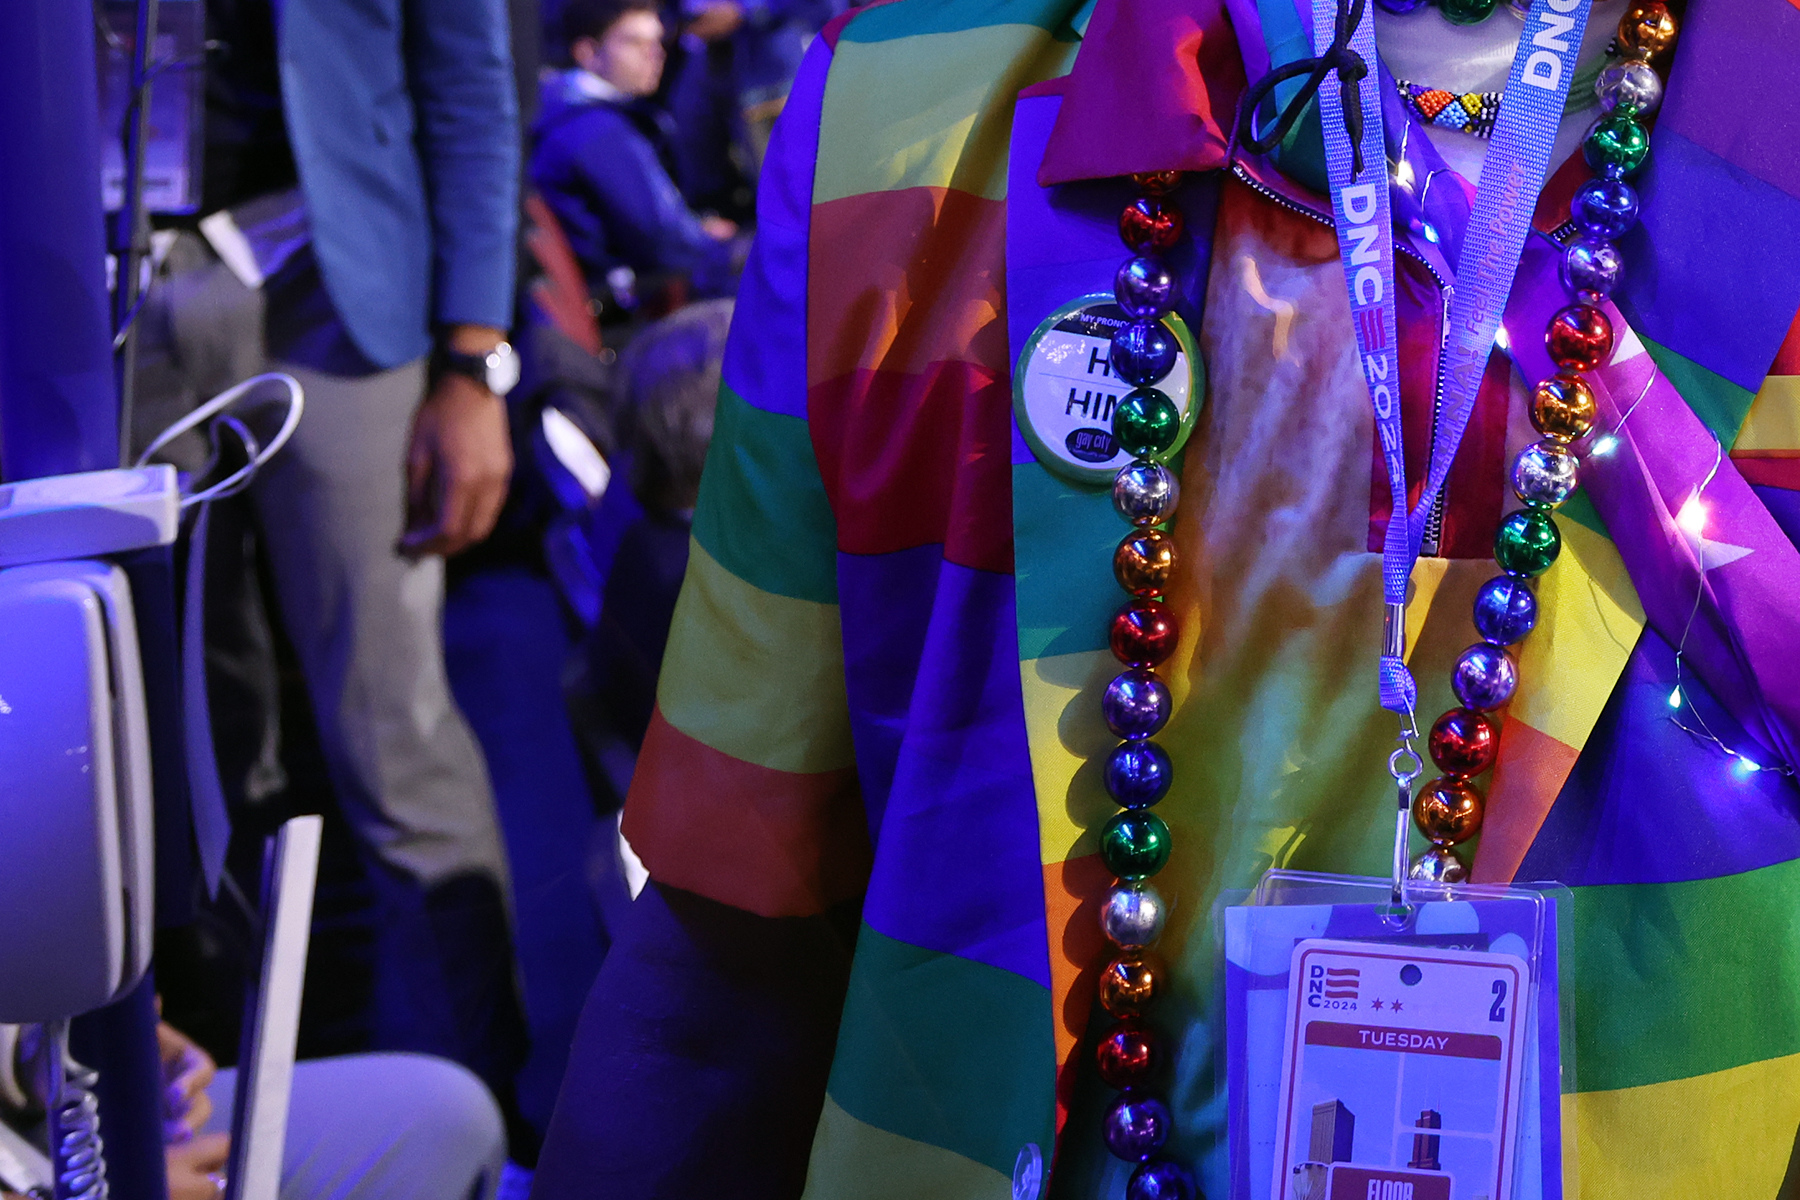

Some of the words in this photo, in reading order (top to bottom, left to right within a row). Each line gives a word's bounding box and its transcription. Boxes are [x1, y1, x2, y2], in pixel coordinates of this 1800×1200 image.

[1489, 161, 1527, 241] Power
[1476, 239, 1505, 287] The
[1080, 313, 1095, 323] MY
[1465, 286, 1492, 336] Feel
[1340, 184, 1384, 306] DNC
[1367, 355, 1402, 489] 2024
[1075, 432, 1093, 450] gay
[1093, 435, 1112, 453] city
[1307, 965, 1325, 1008] DNC
[1323, 1000, 1358, 1011] 2024
[1489, 979, 1507, 1022] 2
[1358, 1030, 1449, 1050] TUESDAY
